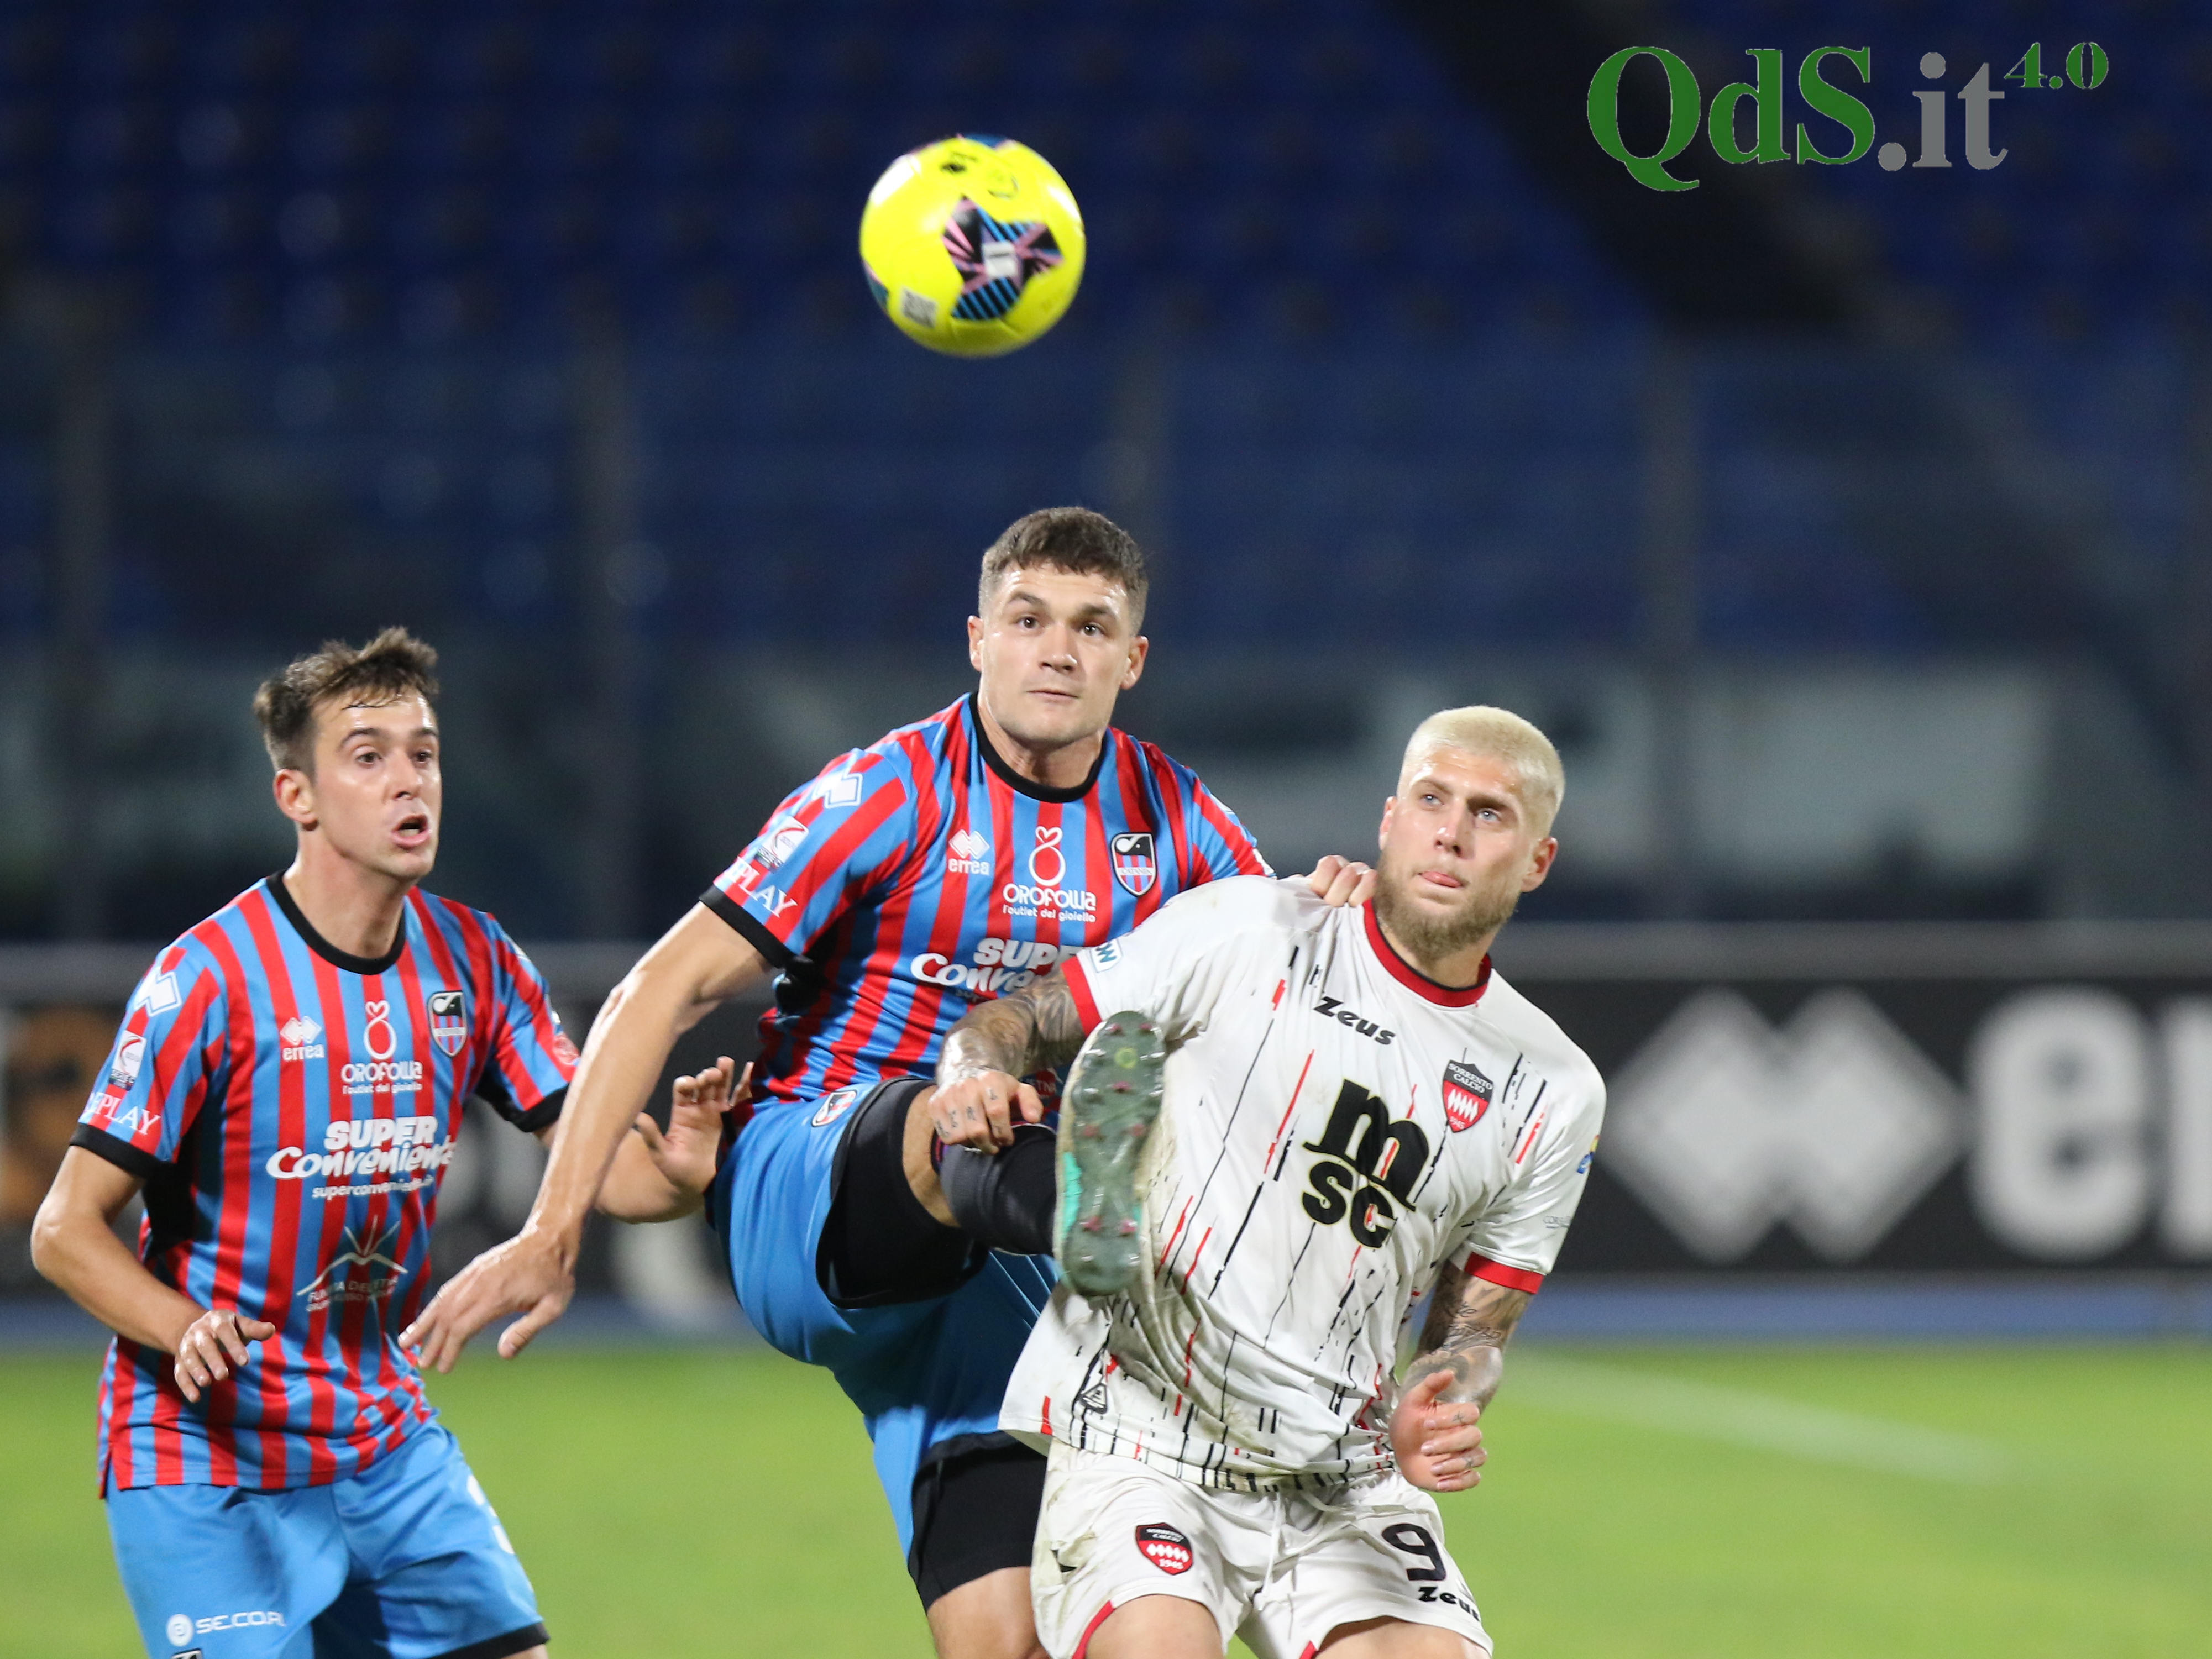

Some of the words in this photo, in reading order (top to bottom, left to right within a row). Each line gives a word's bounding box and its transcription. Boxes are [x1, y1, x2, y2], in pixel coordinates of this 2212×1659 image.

[1040, 908, 1056, 918] del
[1313, 995, 1396, 1046] Zeus
[1453, 1073, 1485, 1093] CALCIO
[323, 1116, 438, 1151] SUPER
[1381, 1523, 1447, 1582] 9
